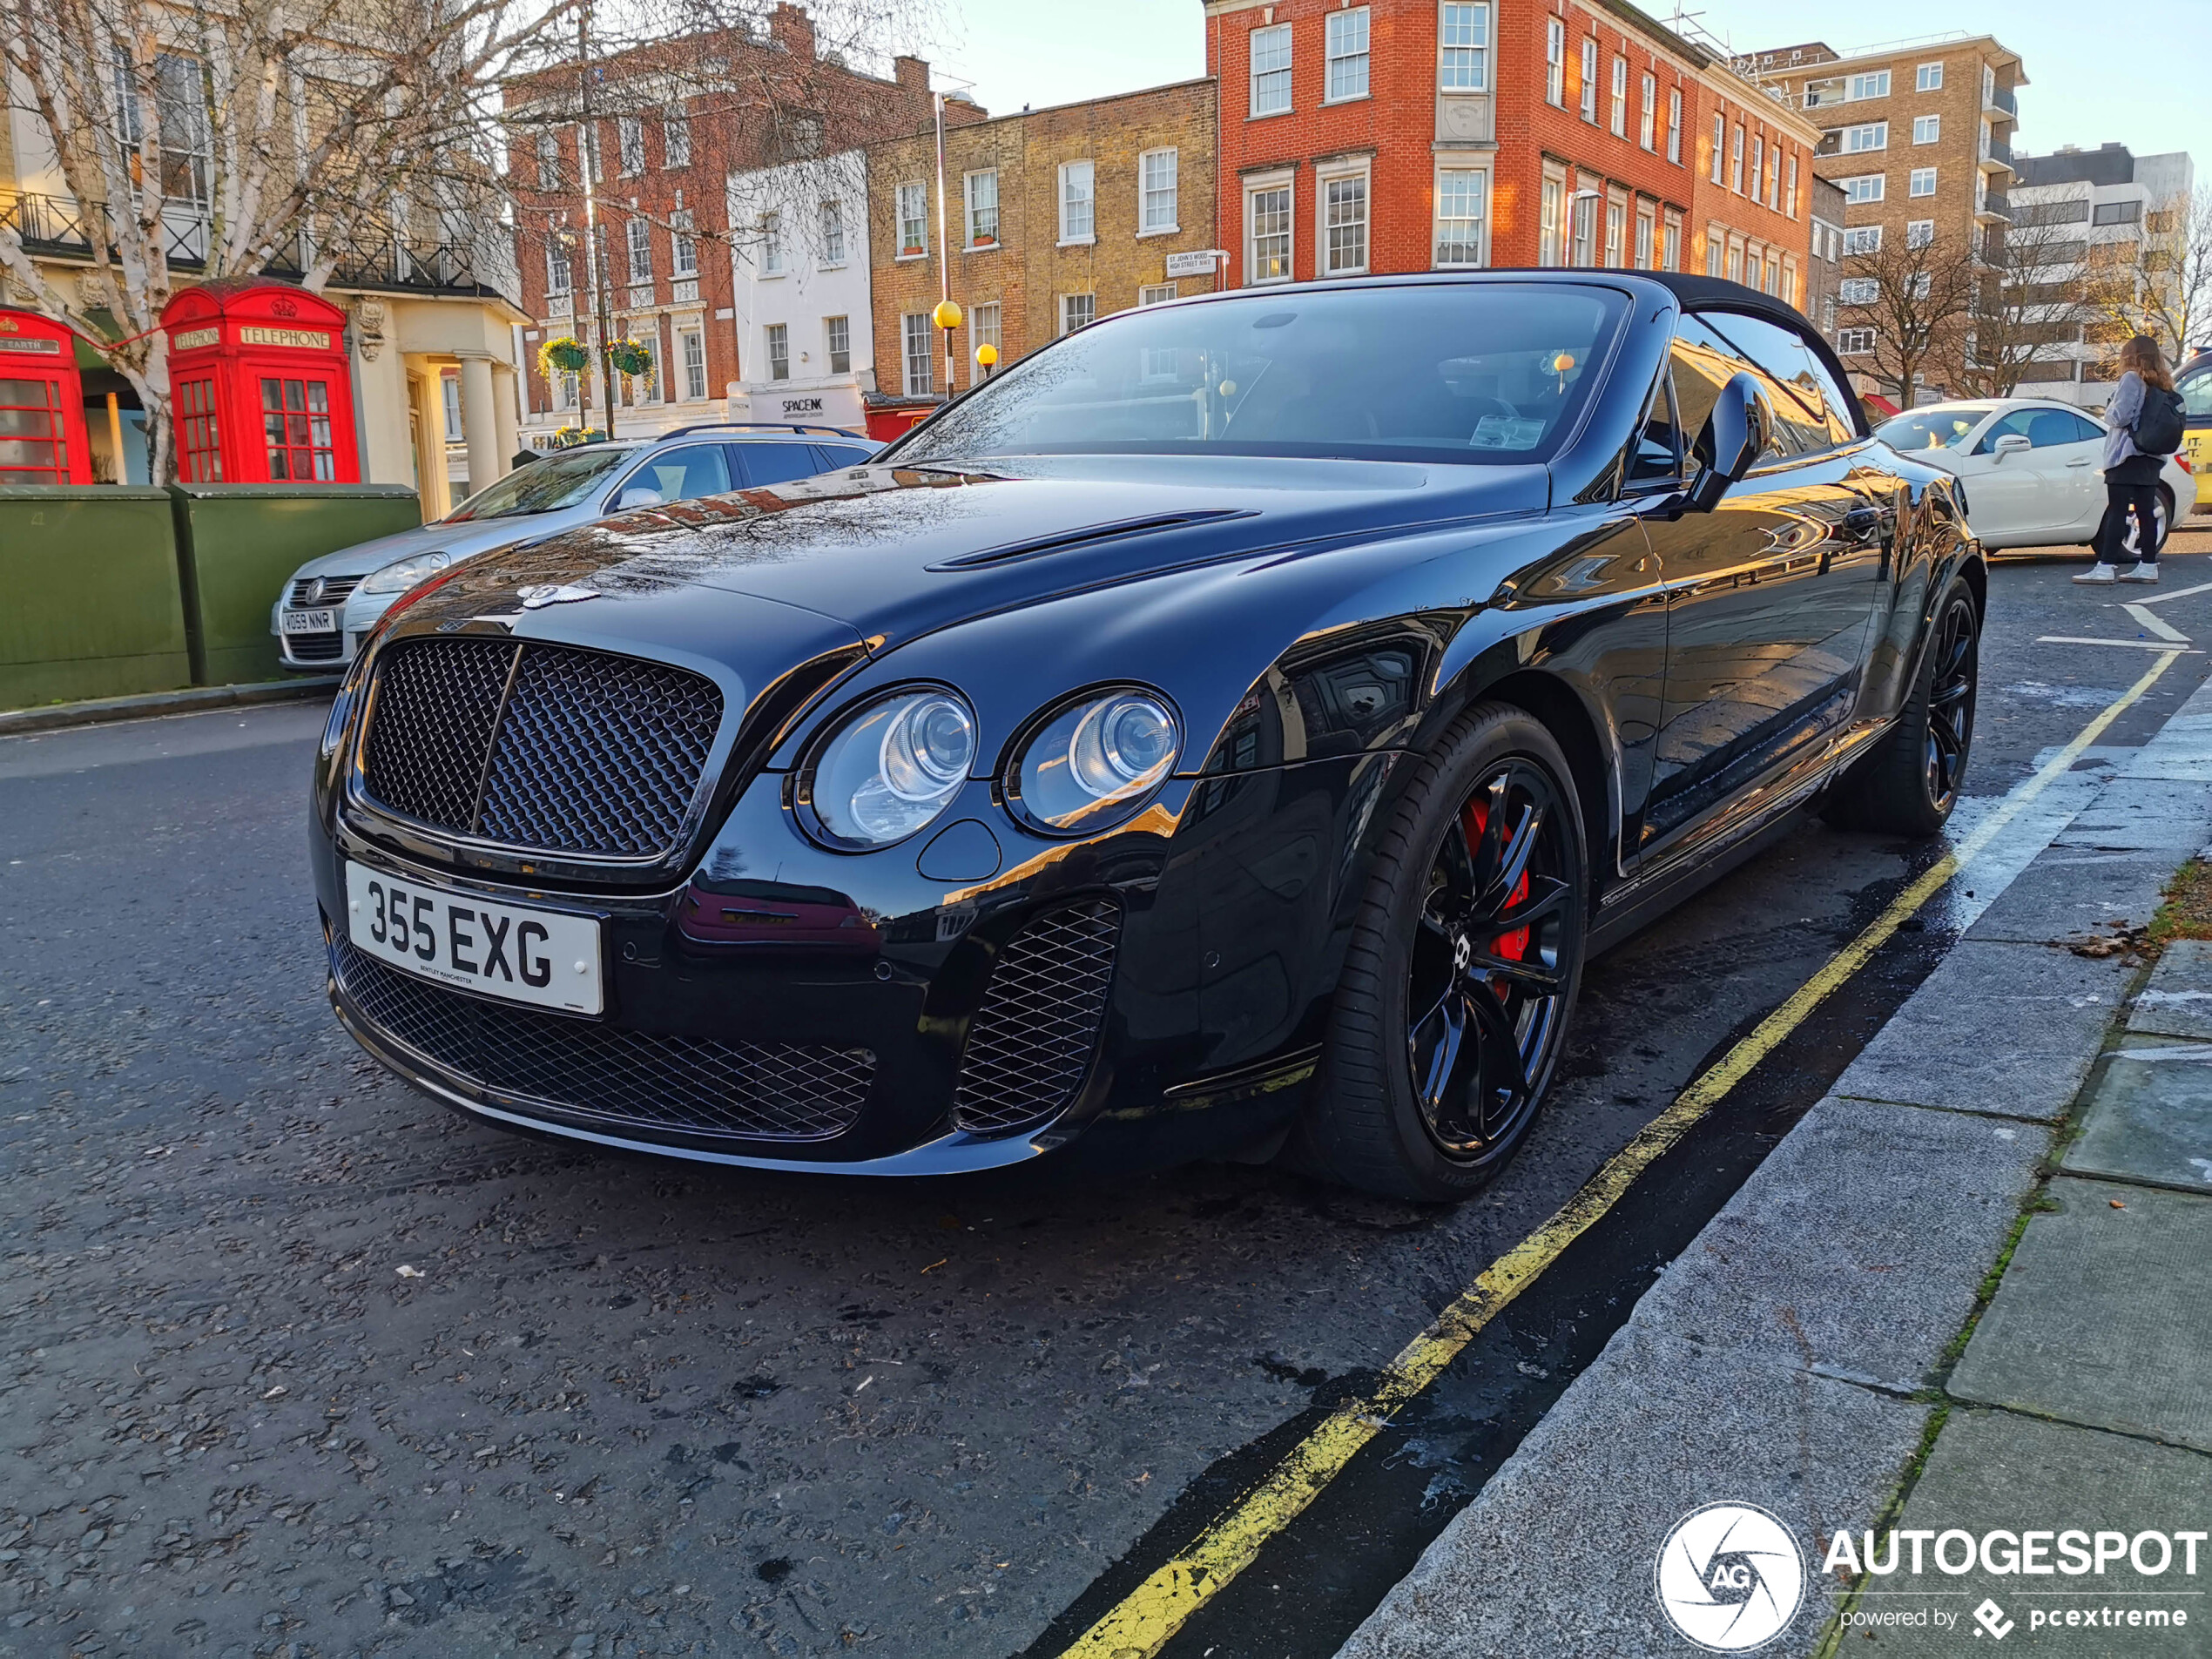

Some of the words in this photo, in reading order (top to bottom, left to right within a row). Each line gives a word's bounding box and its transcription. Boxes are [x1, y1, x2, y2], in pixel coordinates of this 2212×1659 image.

[175, 330, 219, 348] TELEPHONE
[242, 327, 329, 347] TELEPHONE
[308, 611, 330, 628] NNR
[368, 880, 435, 961] 355
[448, 905, 551, 988] EXG
[420, 965, 439, 975] BENTLEY
[440, 971, 472, 984] MANCHESTER
